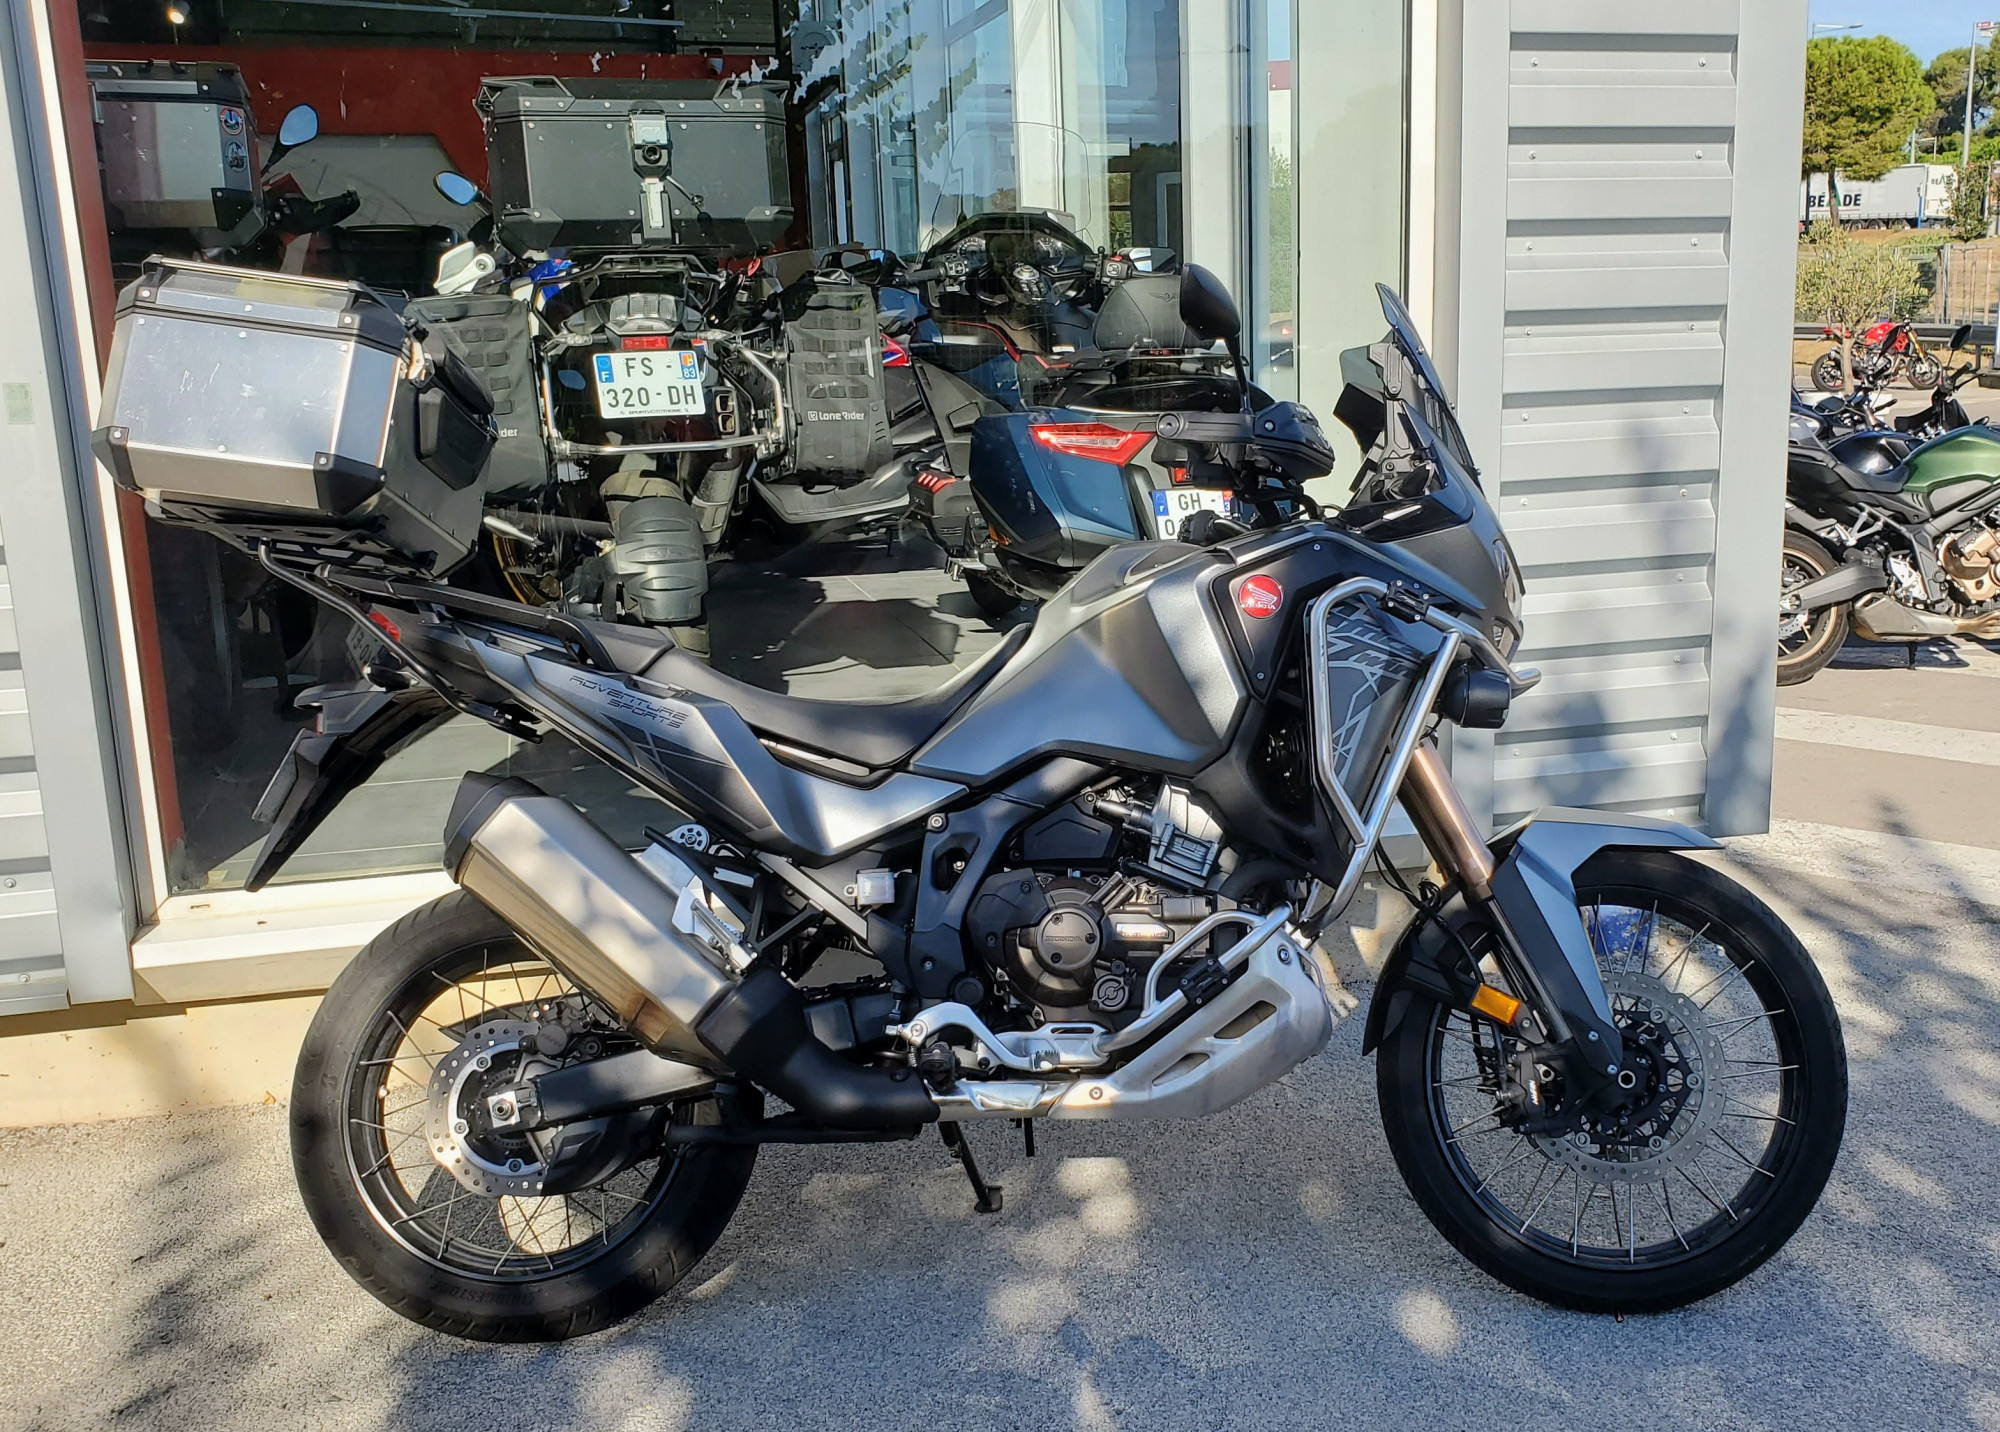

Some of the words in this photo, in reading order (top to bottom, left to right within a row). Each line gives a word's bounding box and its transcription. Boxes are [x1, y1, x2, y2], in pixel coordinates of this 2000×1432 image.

[625, 357, 654, 377] FS
[683, 368, 696, 378] 83
[601, 371, 609, 382] F
[606, 385, 696, 408] 320-DH
[499, 428, 519, 438] der
[1159, 505, 1165, 513] F
[1178, 493, 1202, 511] GH
[569, 675, 688, 722] ADVENTURE
[607, 698, 683, 729] SPORTS
